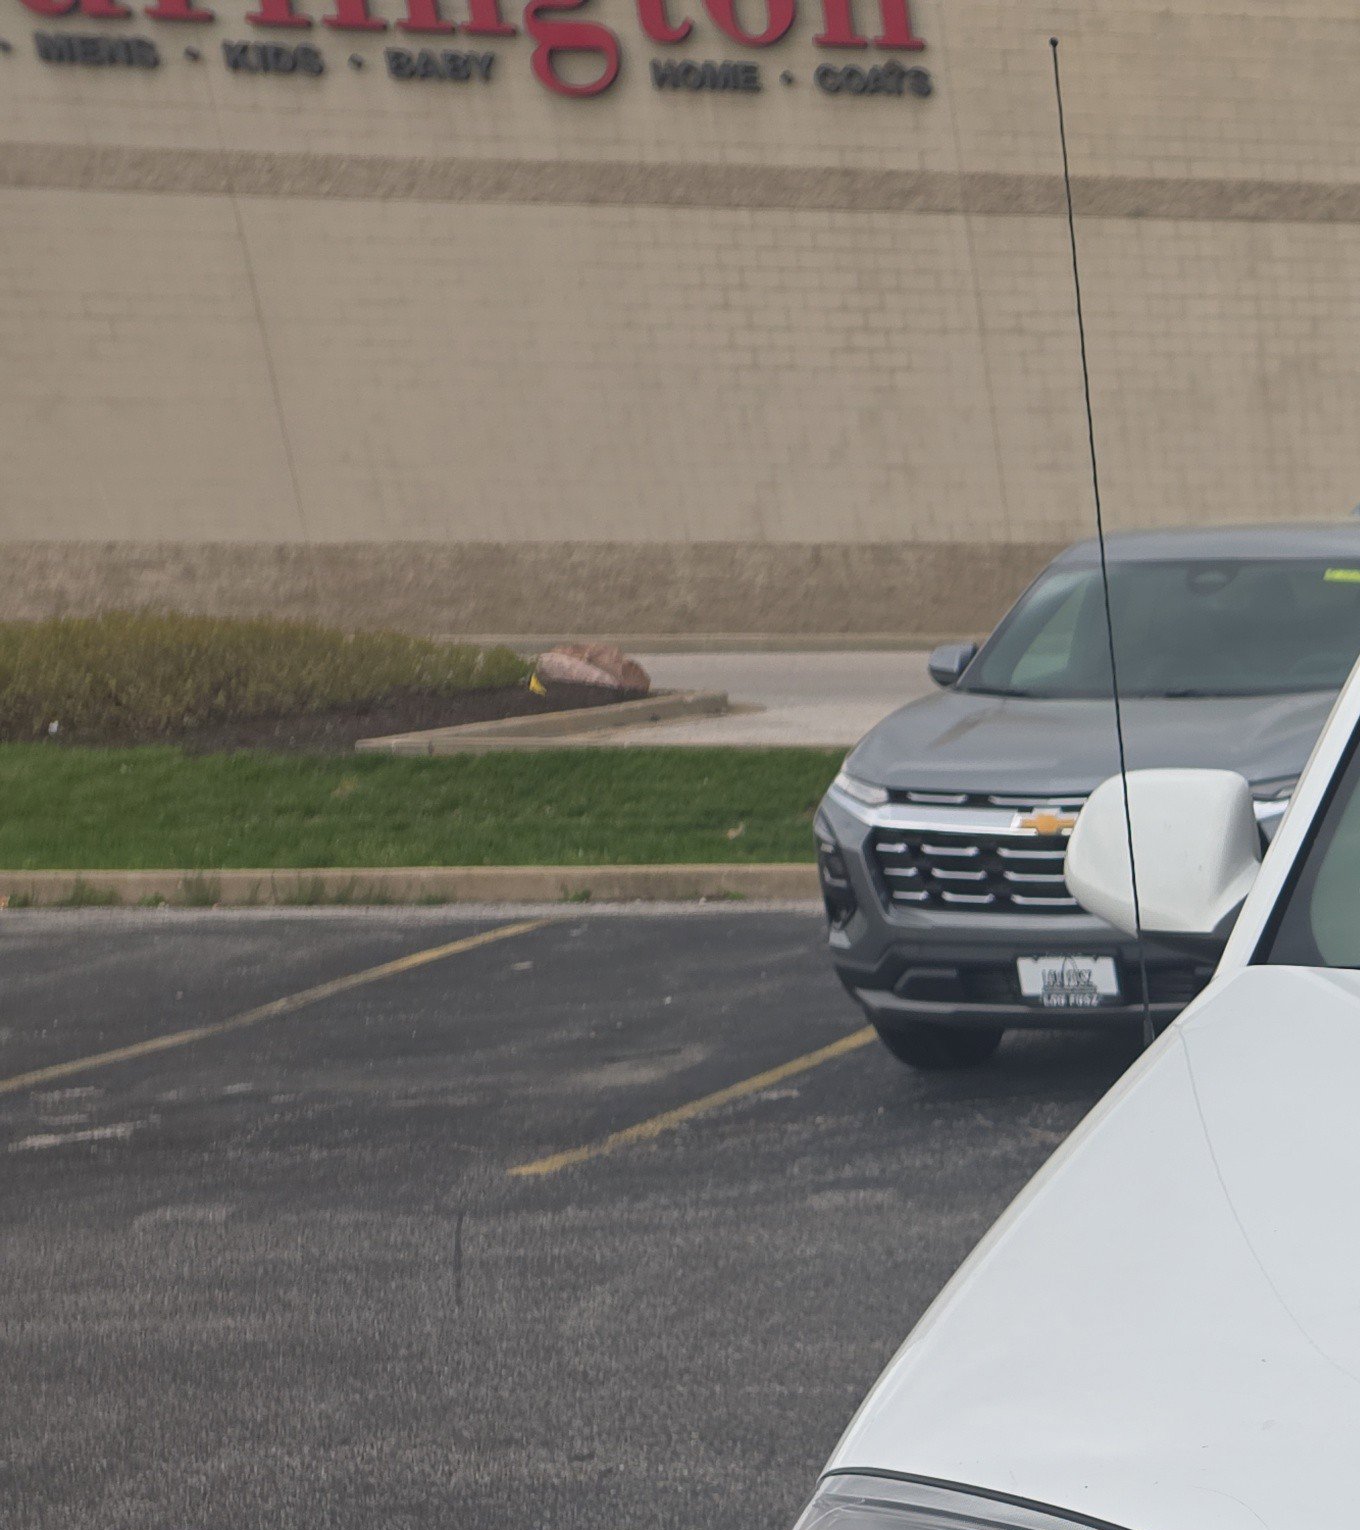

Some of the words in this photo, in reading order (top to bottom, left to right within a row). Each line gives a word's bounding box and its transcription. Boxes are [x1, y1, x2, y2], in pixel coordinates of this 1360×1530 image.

[223, 40, 324, 75] KIDS
[386, 47, 495, 82] BABY
[650, 58, 761, 92] HOME
[813, 60, 933, 97] COATS
